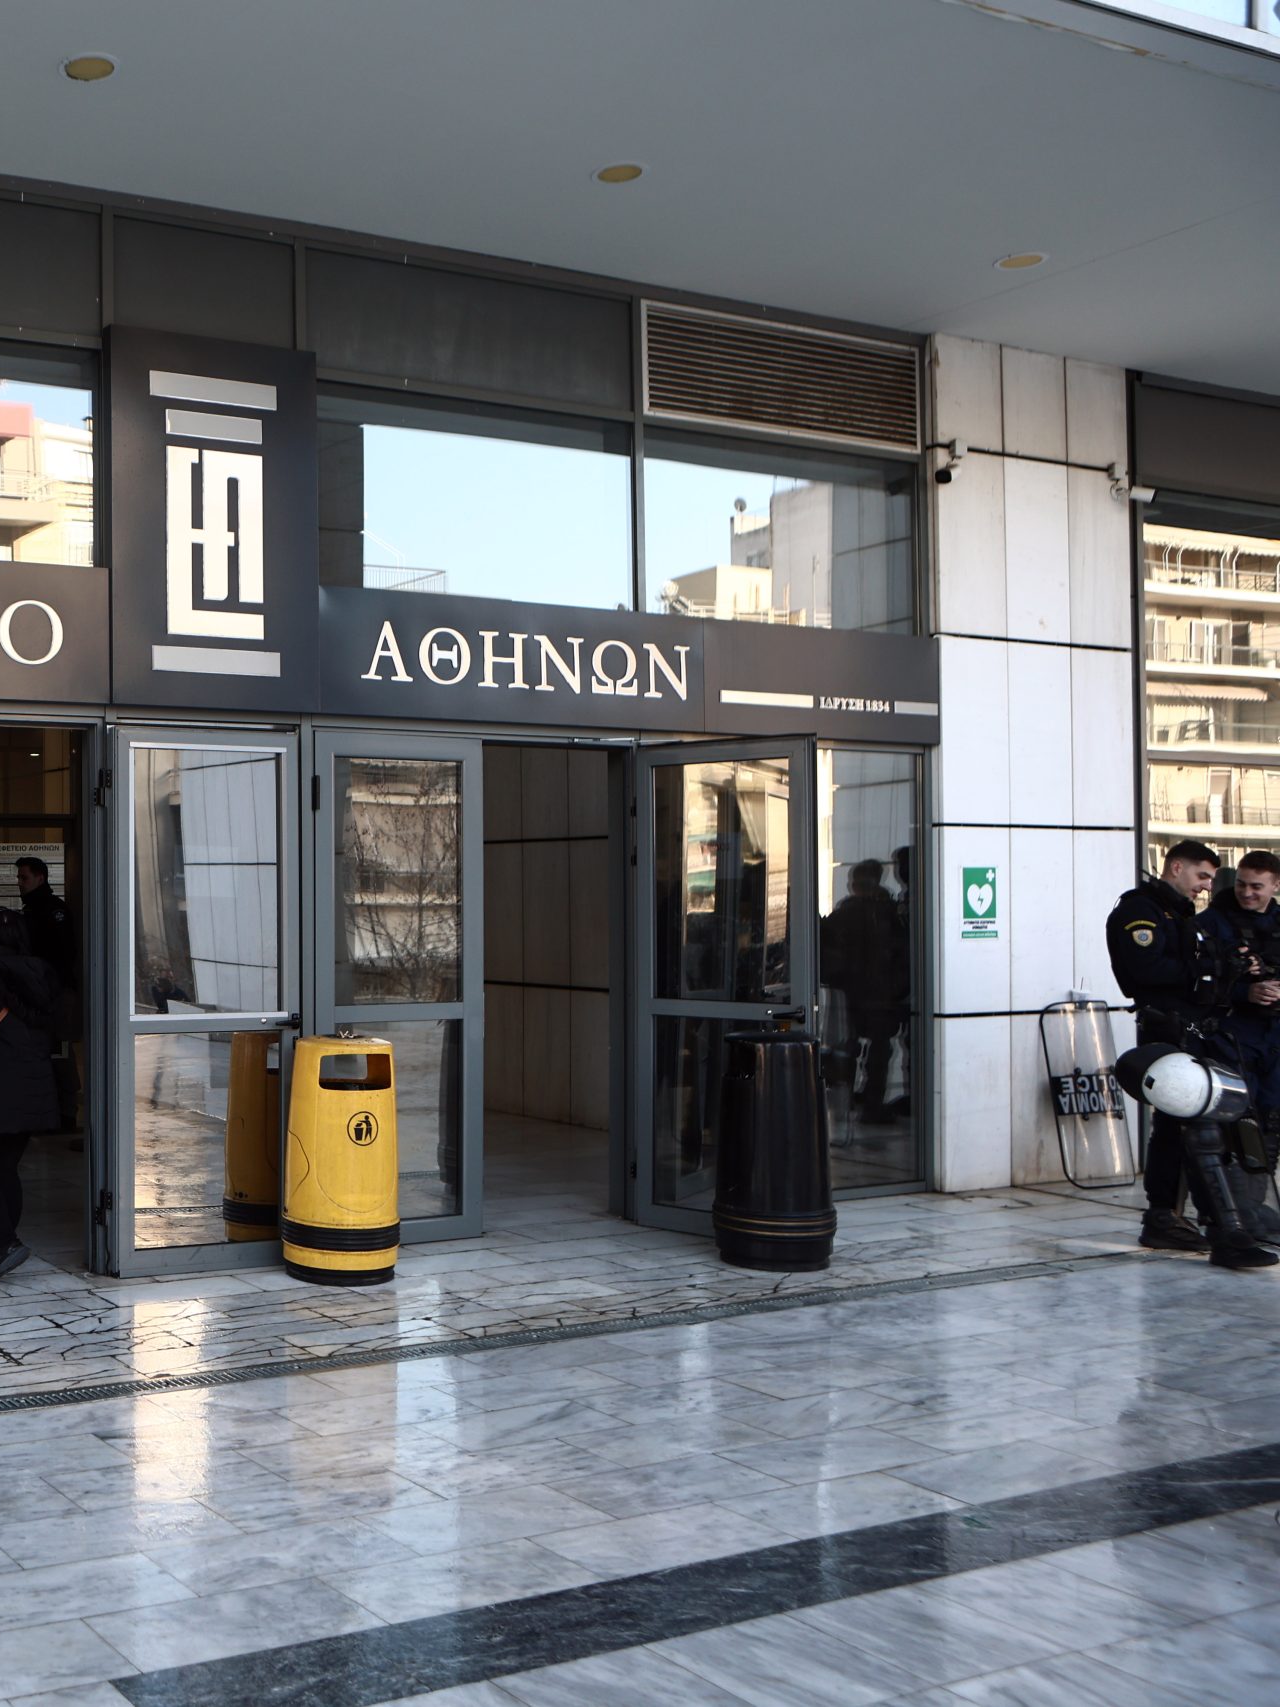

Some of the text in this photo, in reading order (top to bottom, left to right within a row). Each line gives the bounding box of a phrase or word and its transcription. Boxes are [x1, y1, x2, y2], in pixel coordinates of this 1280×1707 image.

[360, 620, 691, 702] ΑΘΗΝΩΝ
[819, 696, 890, 713] ΙΔΡΥΣΗ 1834
[1061, 1074, 1122, 1092] OLICE
